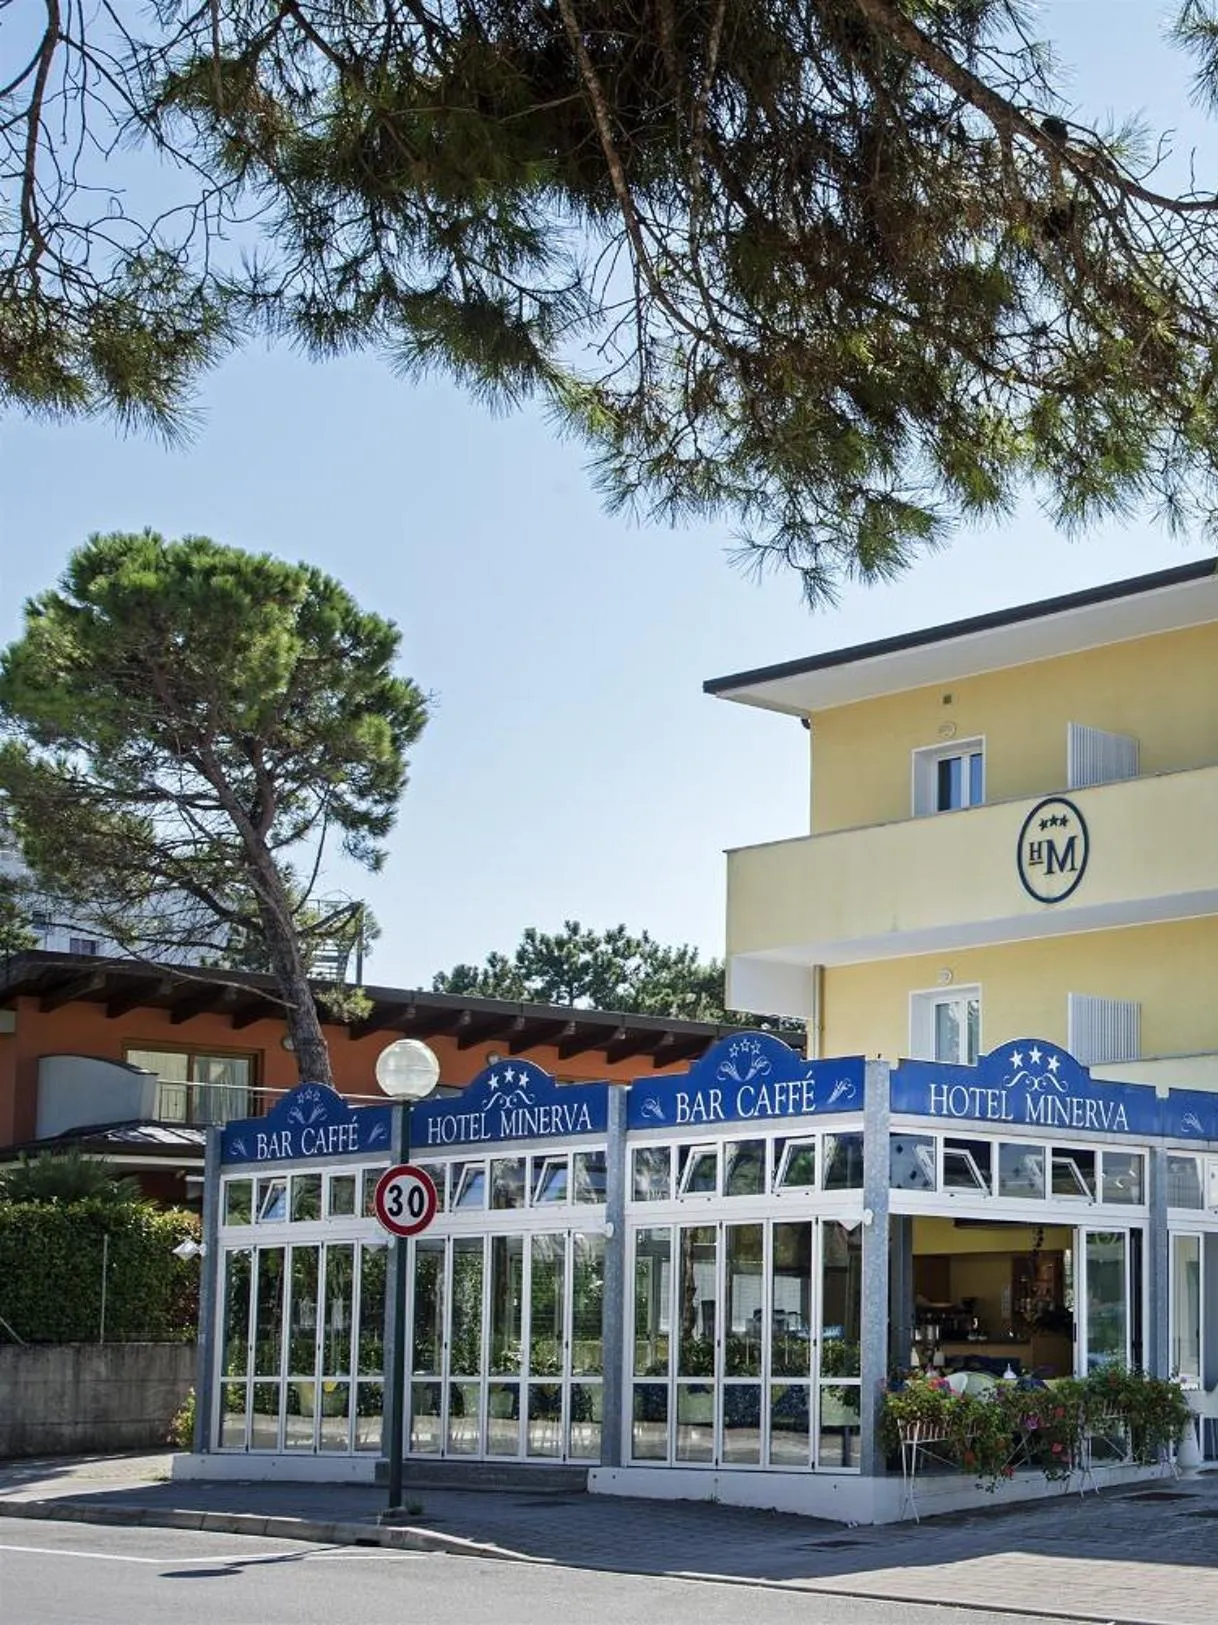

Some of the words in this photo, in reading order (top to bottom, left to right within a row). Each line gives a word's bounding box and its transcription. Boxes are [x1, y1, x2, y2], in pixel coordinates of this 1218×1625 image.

[676, 1089, 725, 1123] BAR
[736, 1070, 816, 1118] CAFFÉ
[929, 1083, 1014, 1121] HOTEL
[1024, 1093, 1130, 1131] MINERVA
[256, 1130, 294, 1160] BAR
[301, 1116, 359, 1155] CAFFÉ
[427, 1112, 492, 1144] HOTEL
[500, 1102, 592, 1137] MINERVA
[388, 1184, 425, 1218] 30
